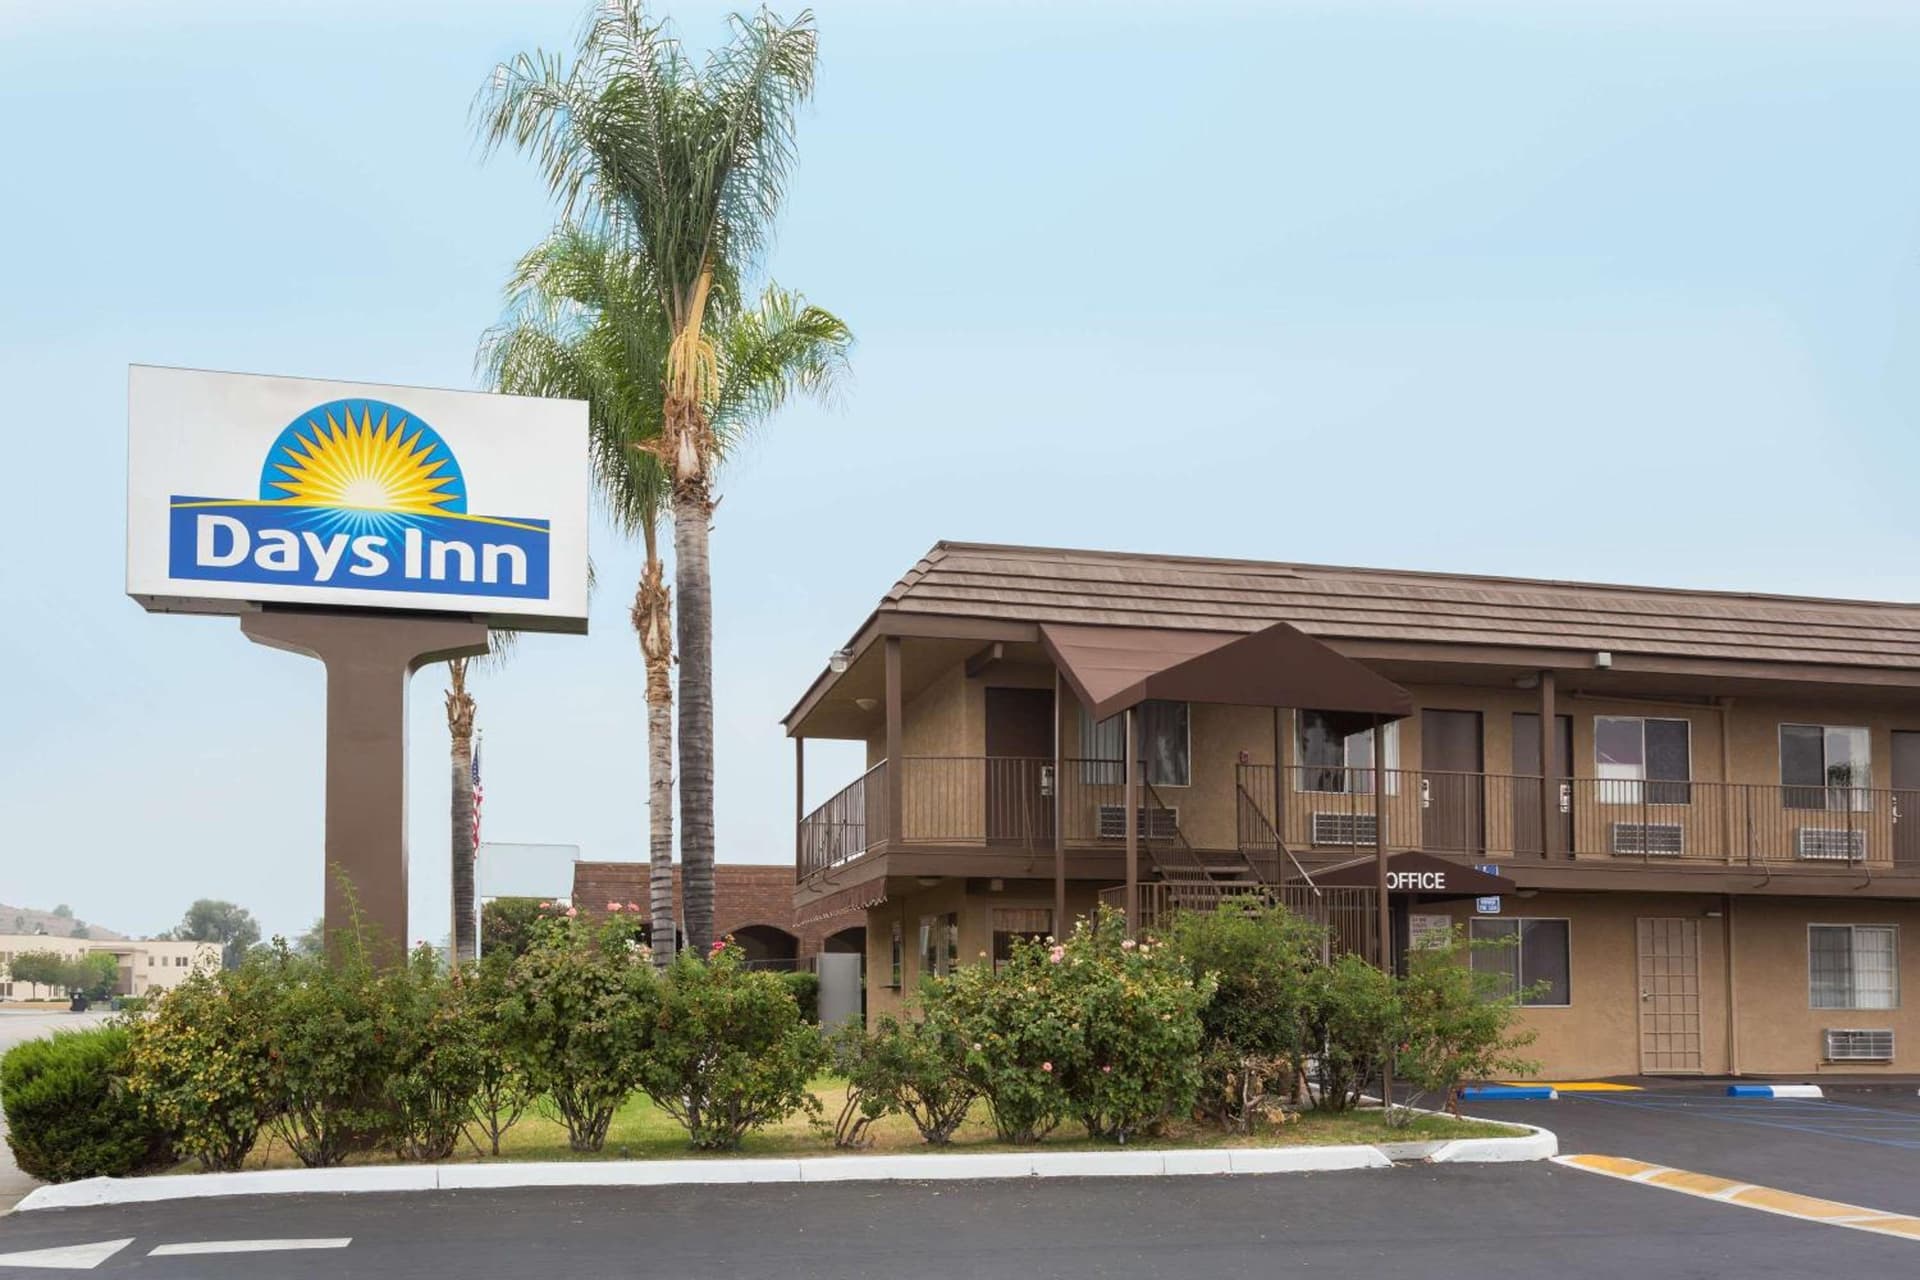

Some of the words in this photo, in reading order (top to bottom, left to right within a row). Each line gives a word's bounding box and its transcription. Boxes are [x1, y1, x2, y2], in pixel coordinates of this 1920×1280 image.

[196, 514, 390, 582] Days
[404, 528, 527, 585] Inn
[1386, 872, 1446, 889] OFFICE
